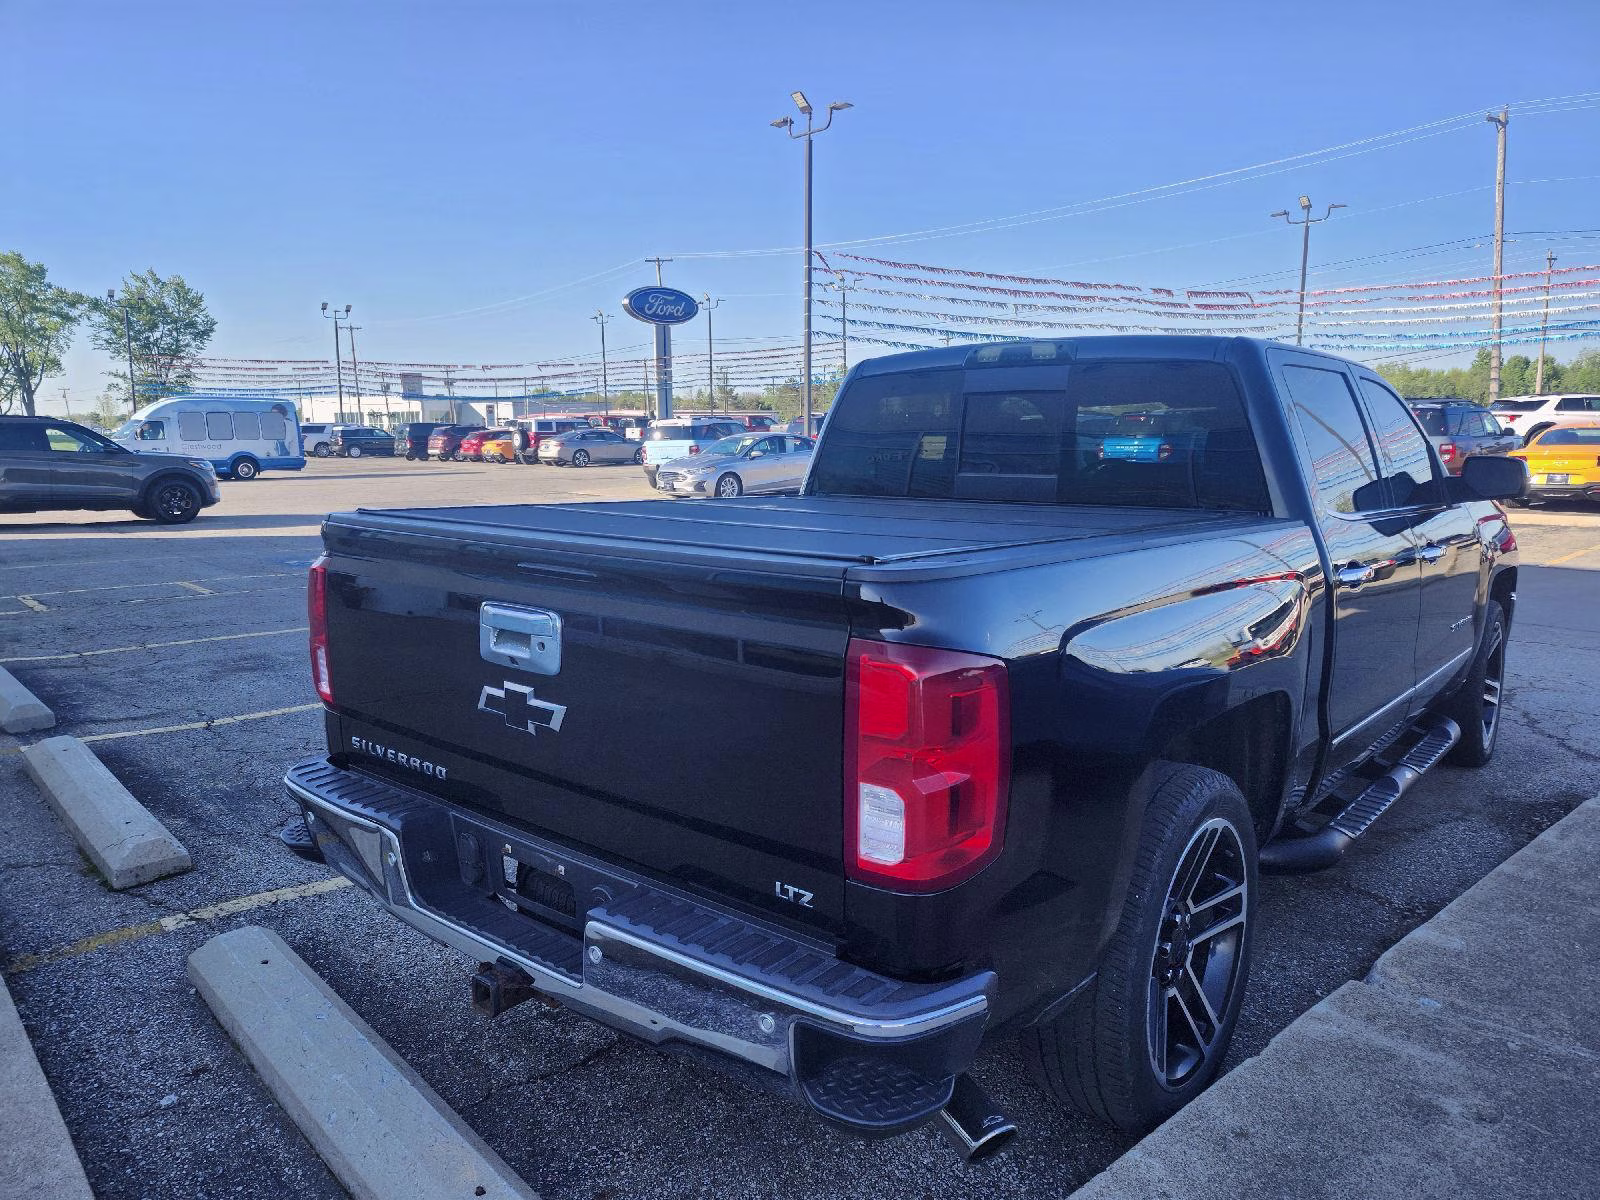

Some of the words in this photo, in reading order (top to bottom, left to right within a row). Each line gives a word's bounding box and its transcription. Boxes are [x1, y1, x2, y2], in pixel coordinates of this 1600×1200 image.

[644, 293, 686, 317] Ford
[351, 736, 448, 780] SILVERADO
[775, 881, 814, 908] LTZ
